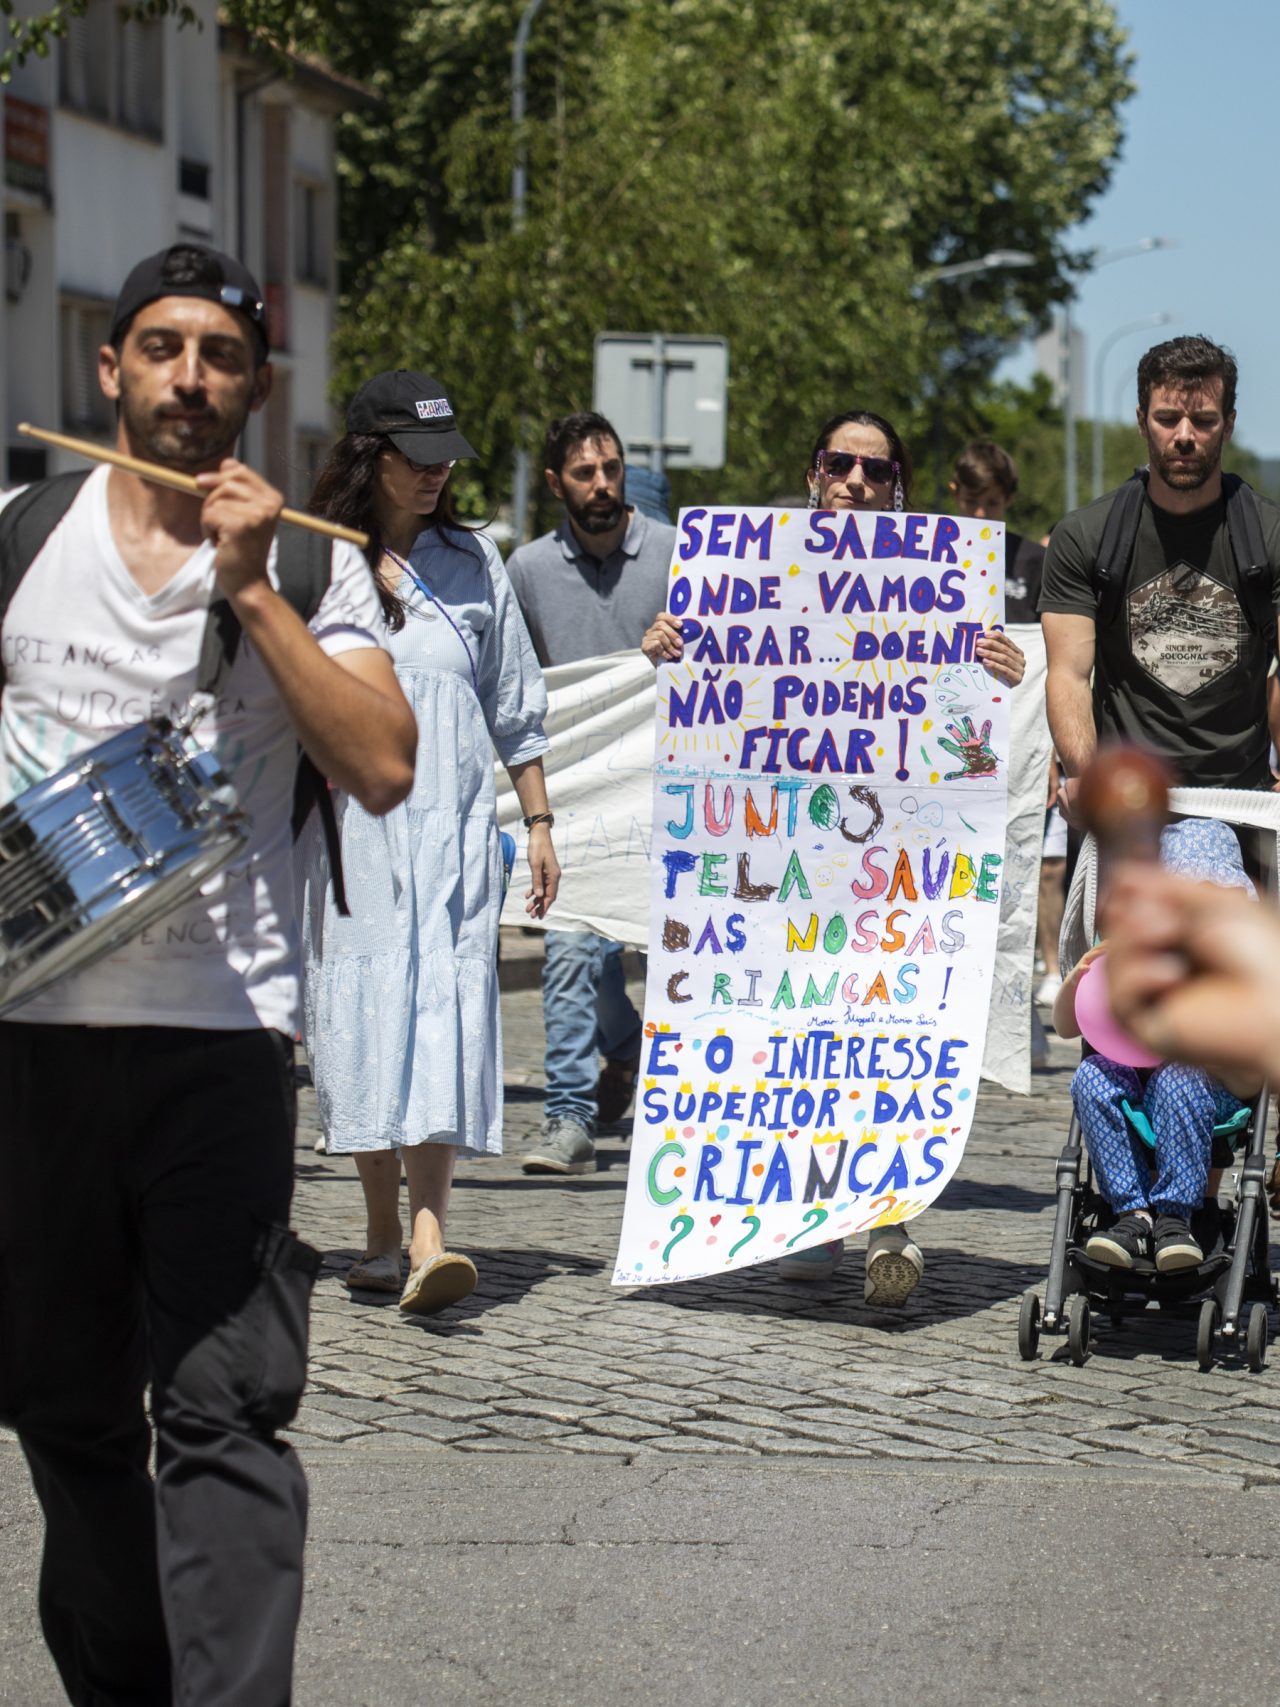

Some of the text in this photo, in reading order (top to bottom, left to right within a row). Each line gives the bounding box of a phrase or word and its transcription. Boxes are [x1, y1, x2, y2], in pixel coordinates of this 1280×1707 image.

[417, 400, 452, 417] MARVEL
[679, 509, 960, 563] SEM SABER
[669, 573, 781, 616] ONDE
[819, 570, 965, 614] VAMOS
[669, 669, 742, 728] NÃO
[773, 675, 927, 720] PODEMOS
[664, 781, 884, 843] JUNTOS
[661, 837, 1002, 904] PELA SAÚDE
[661, 910, 964, 956] DAS NOSSAS
[647, 1030, 968, 1080] E O INTERESSE
[643, 1083, 953, 1130] SUPERIOR DAS
[647, 1136, 949, 1206] CRIANÇAS
